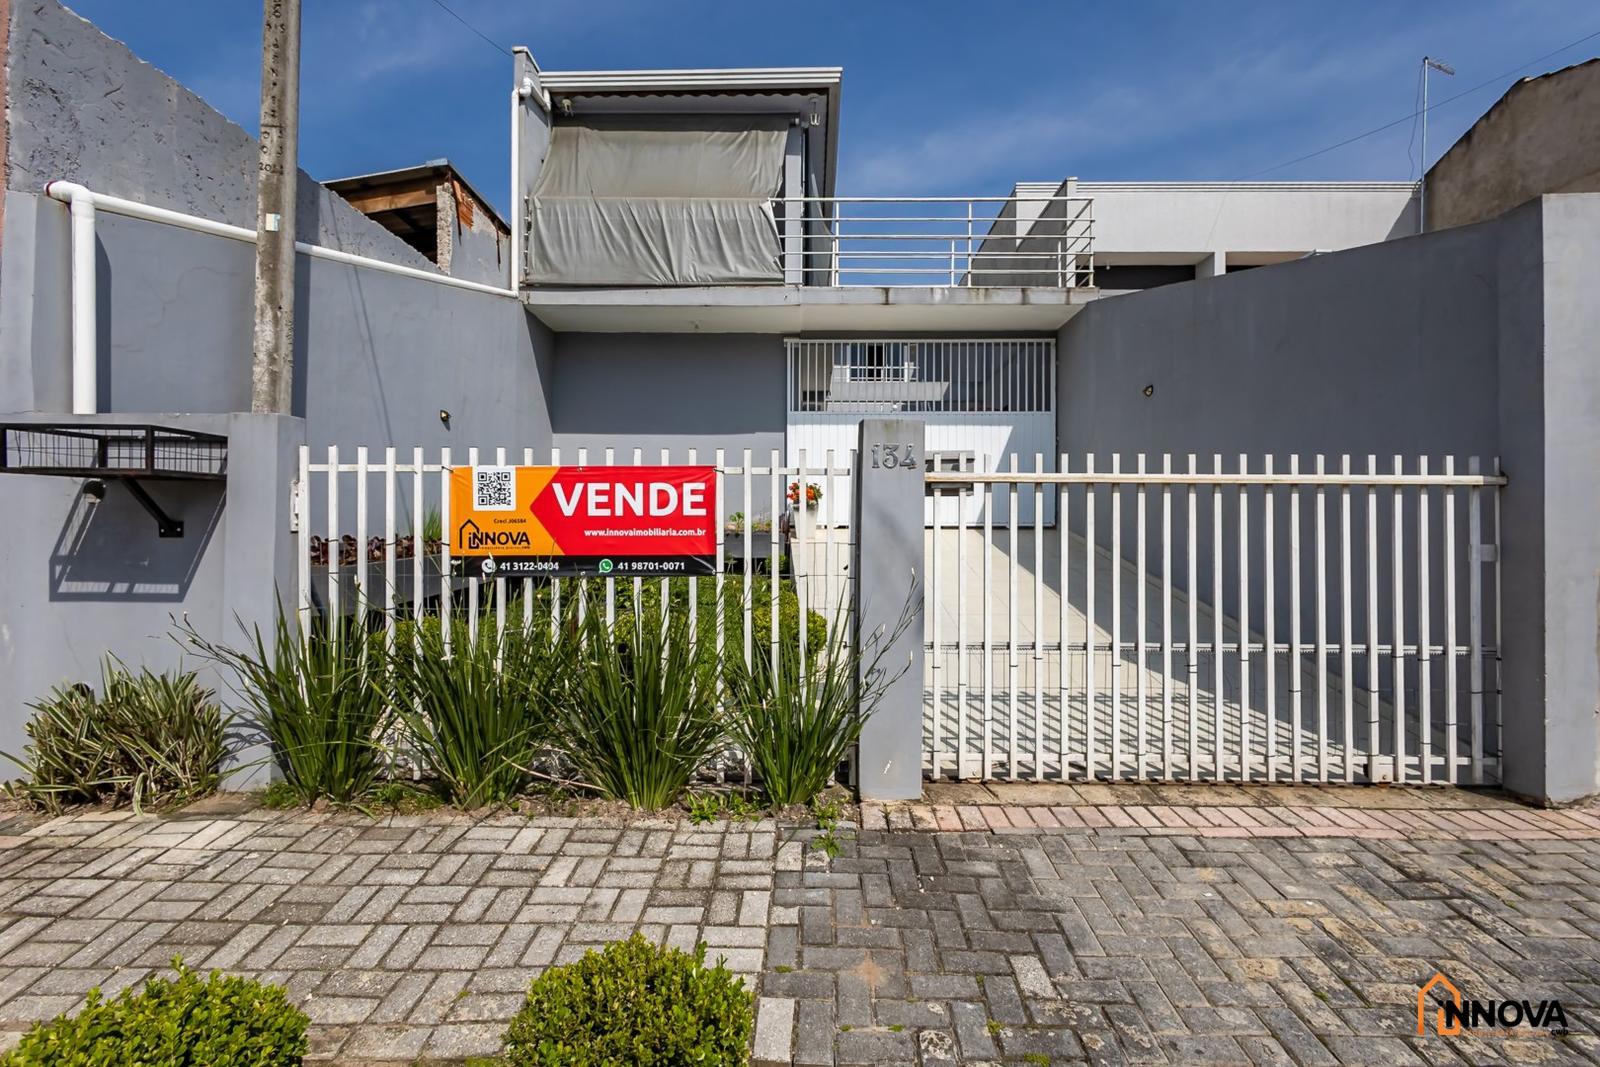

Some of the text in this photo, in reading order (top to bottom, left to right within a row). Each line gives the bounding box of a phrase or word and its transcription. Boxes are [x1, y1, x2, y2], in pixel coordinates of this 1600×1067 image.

[871, 443, 918, 469] 134
[551, 482, 707, 517] VENDE
[584, 527, 707, 536] www.innovaimobiliaria.com.br
[499, 561, 560, 571] 41 3122-0404
[617, 561, 685, 570] 41 98701-0071
